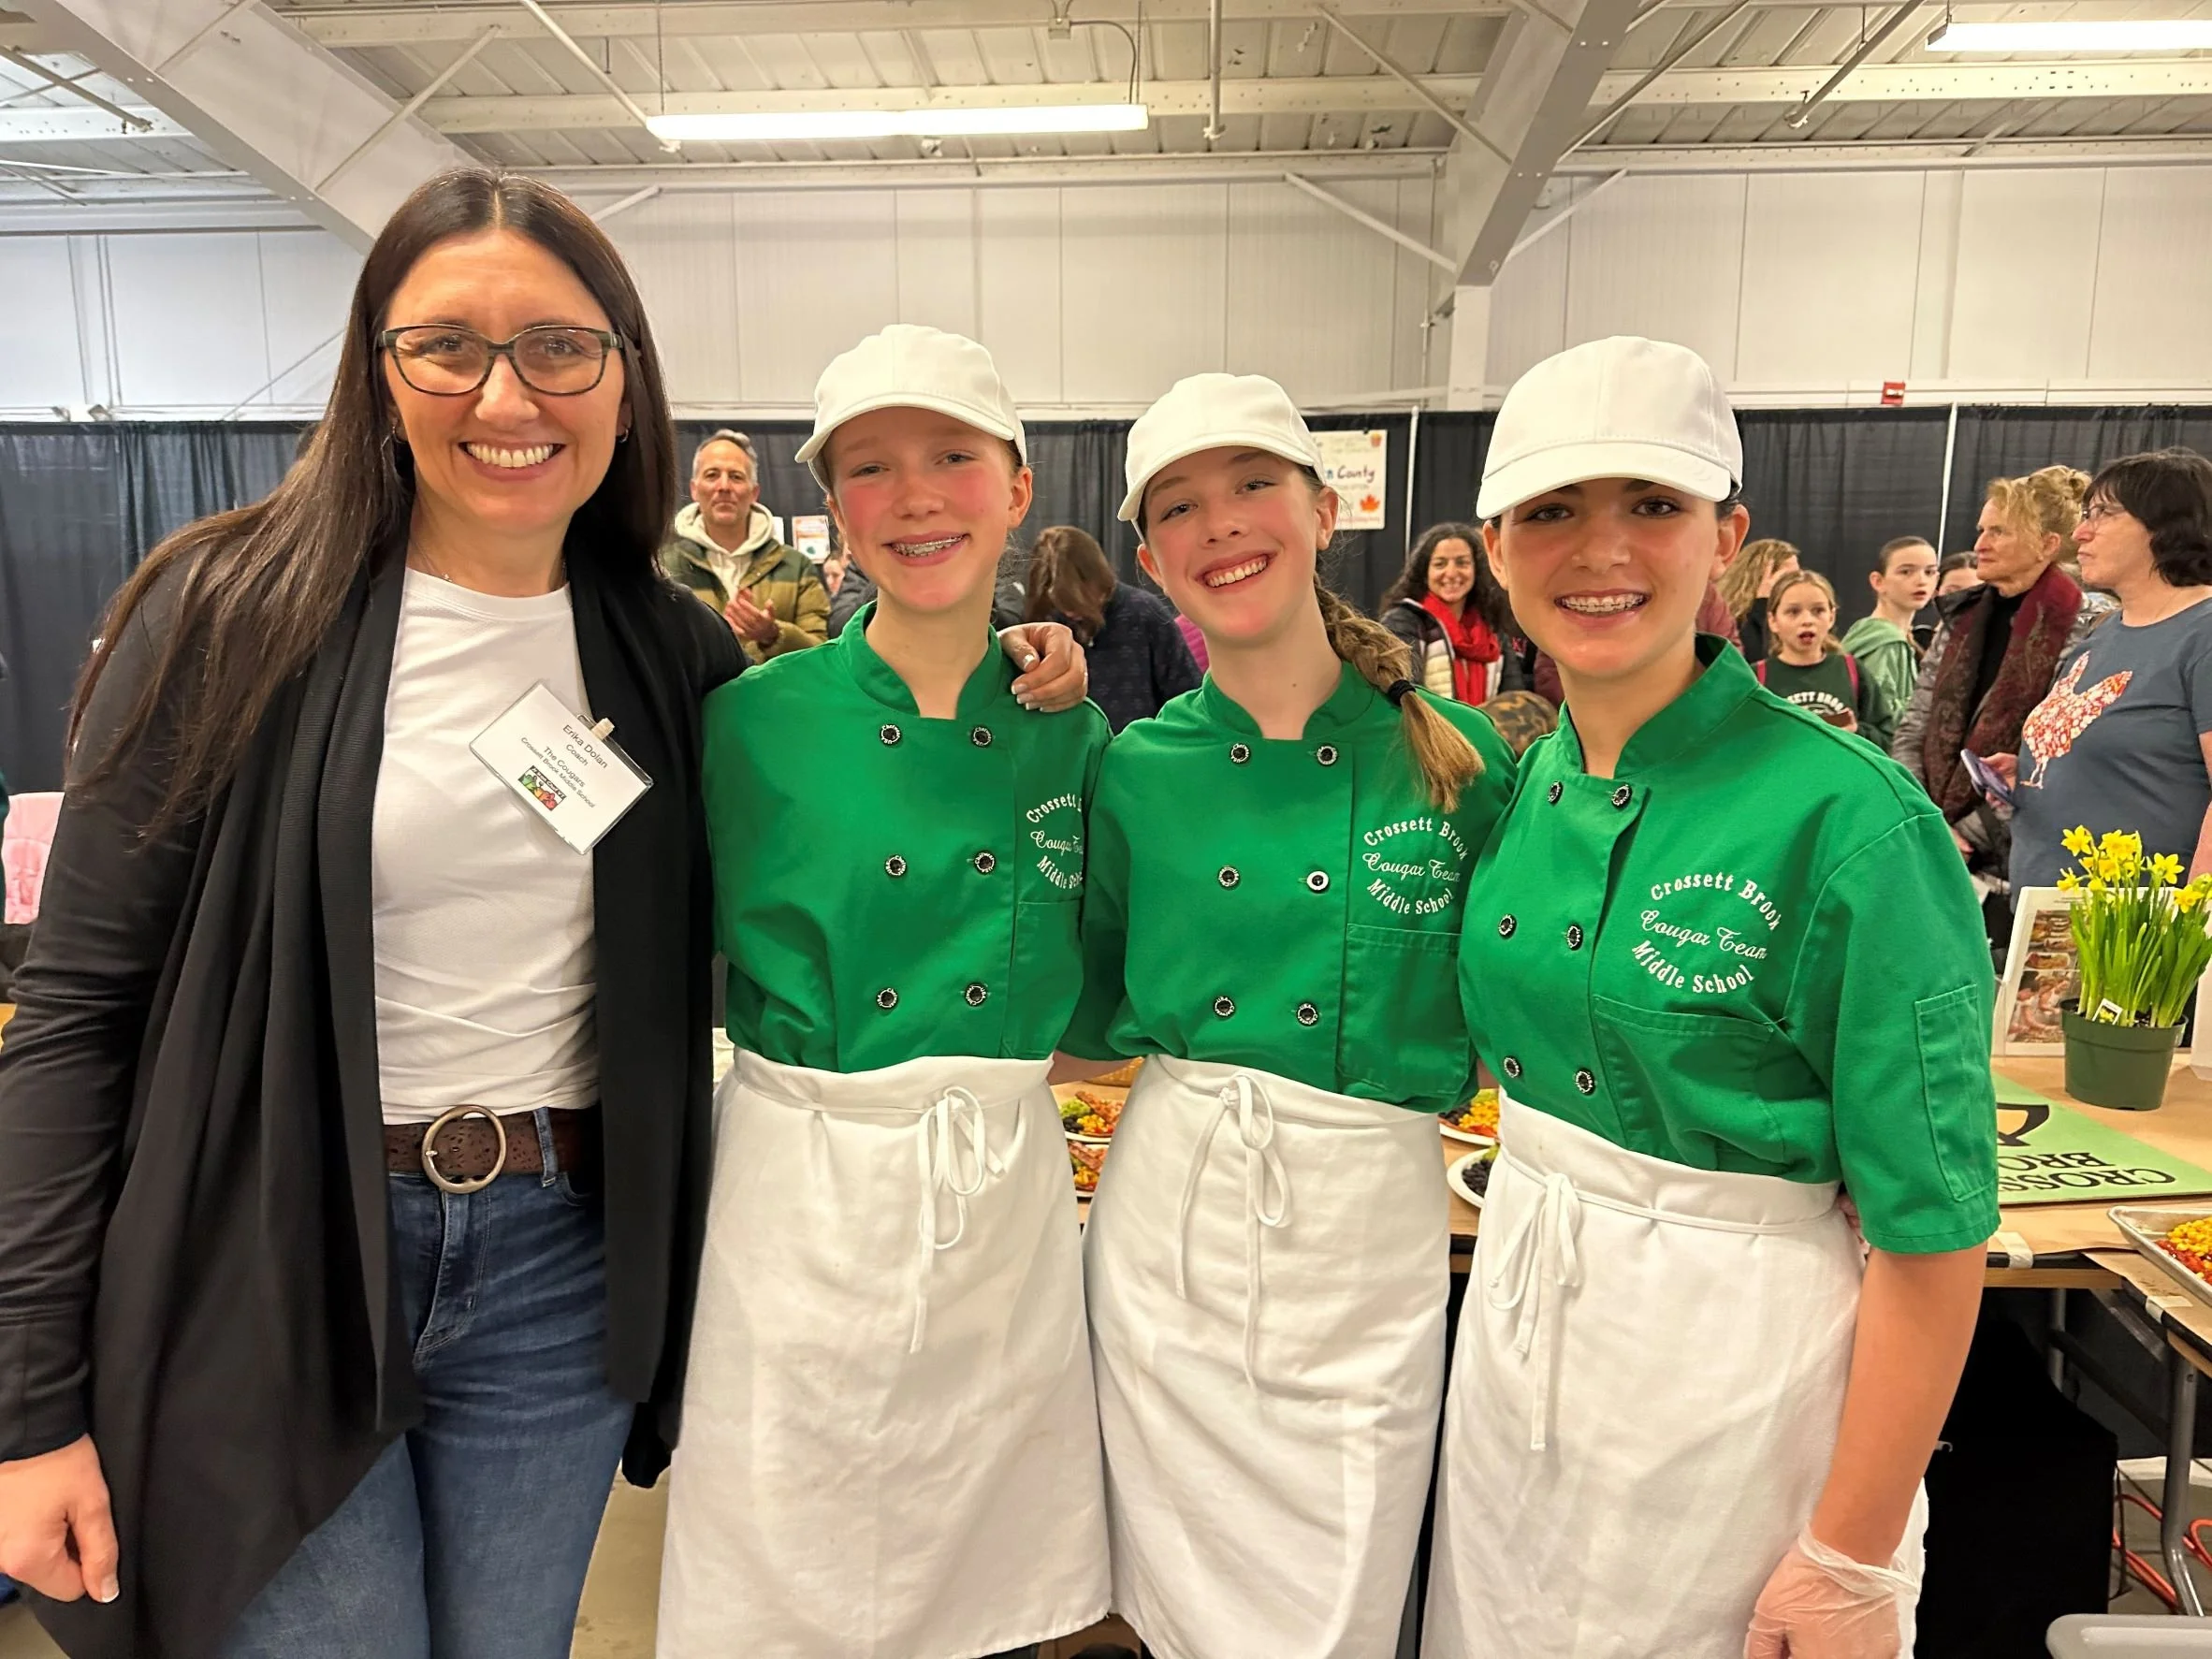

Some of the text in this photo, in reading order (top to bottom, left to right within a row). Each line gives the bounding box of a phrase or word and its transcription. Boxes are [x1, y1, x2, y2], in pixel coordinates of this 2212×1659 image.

[1337, 465, 1375, 483] County
[563, 724, 608, 769] Erika Dolan
[566, 743, 589, 766] Coach
[521, 737, 595, 808] Crossett Brook Middle School
[544, 746, 586, 788] The Cougars
[1364, 816, 1468, 861] Crossett Brook
[1036, 855, 1067, 889] Middle
[1362, 852, 1425, 881] Cougar
[1367, 878, 1455, 914] Middle School
[1651, 872, 1781, 931] Crossett Brook
[1641, 910, 1711, 947] Cougar
[1632, 940, 1755, 993] Middle School
[1998, 1168, 2176, 1192] CROSS
